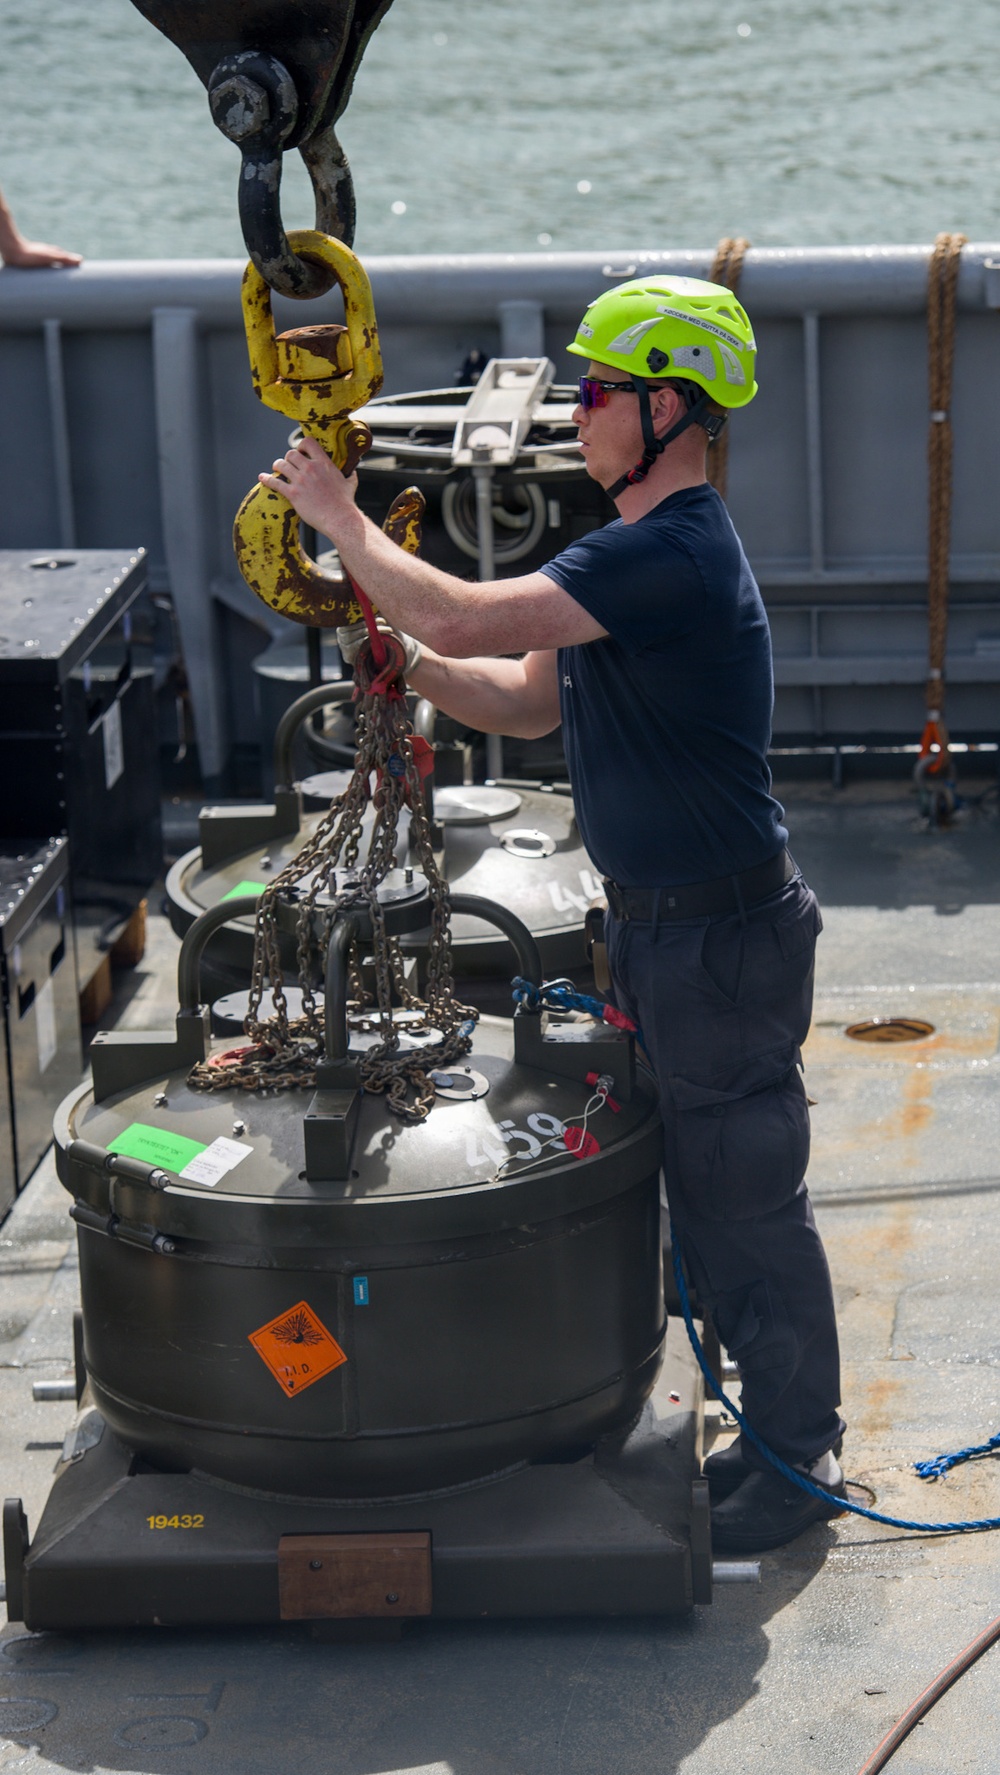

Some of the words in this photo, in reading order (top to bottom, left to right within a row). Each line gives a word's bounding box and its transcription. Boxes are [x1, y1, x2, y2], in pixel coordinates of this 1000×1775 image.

[688, 316, 700, 325] MED
[701, 322, 719, 334] GUTTA
[465, 1112, 568, 1168] 459
[146, 1514, 204, 1529] 19432
